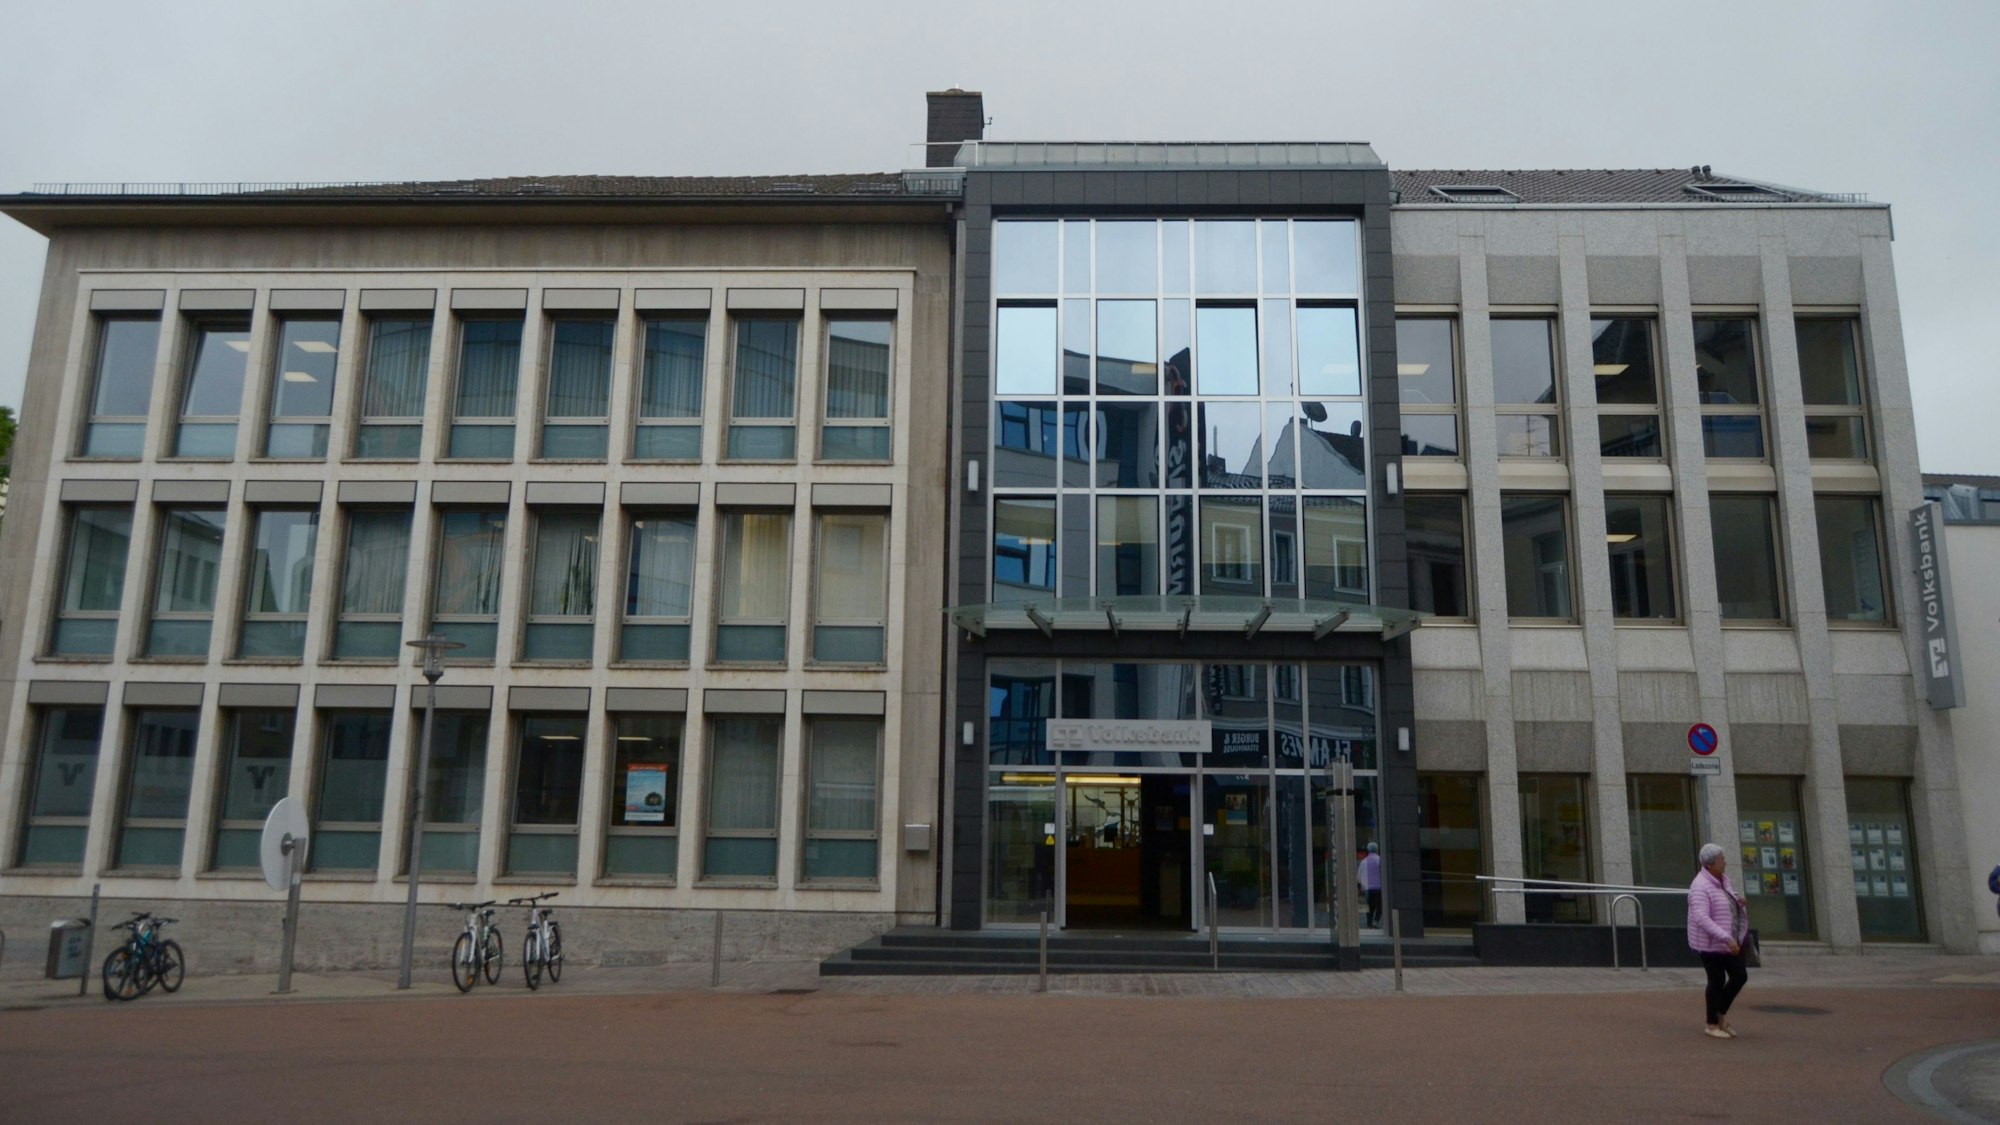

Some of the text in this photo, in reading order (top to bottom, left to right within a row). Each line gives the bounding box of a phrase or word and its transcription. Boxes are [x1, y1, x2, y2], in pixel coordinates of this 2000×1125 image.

[1914, 510, 1940, 632] Volksbank
[1088, 725, 1200, 745] Volksbank
[1691, 762, 1719, 770] Ladezone
